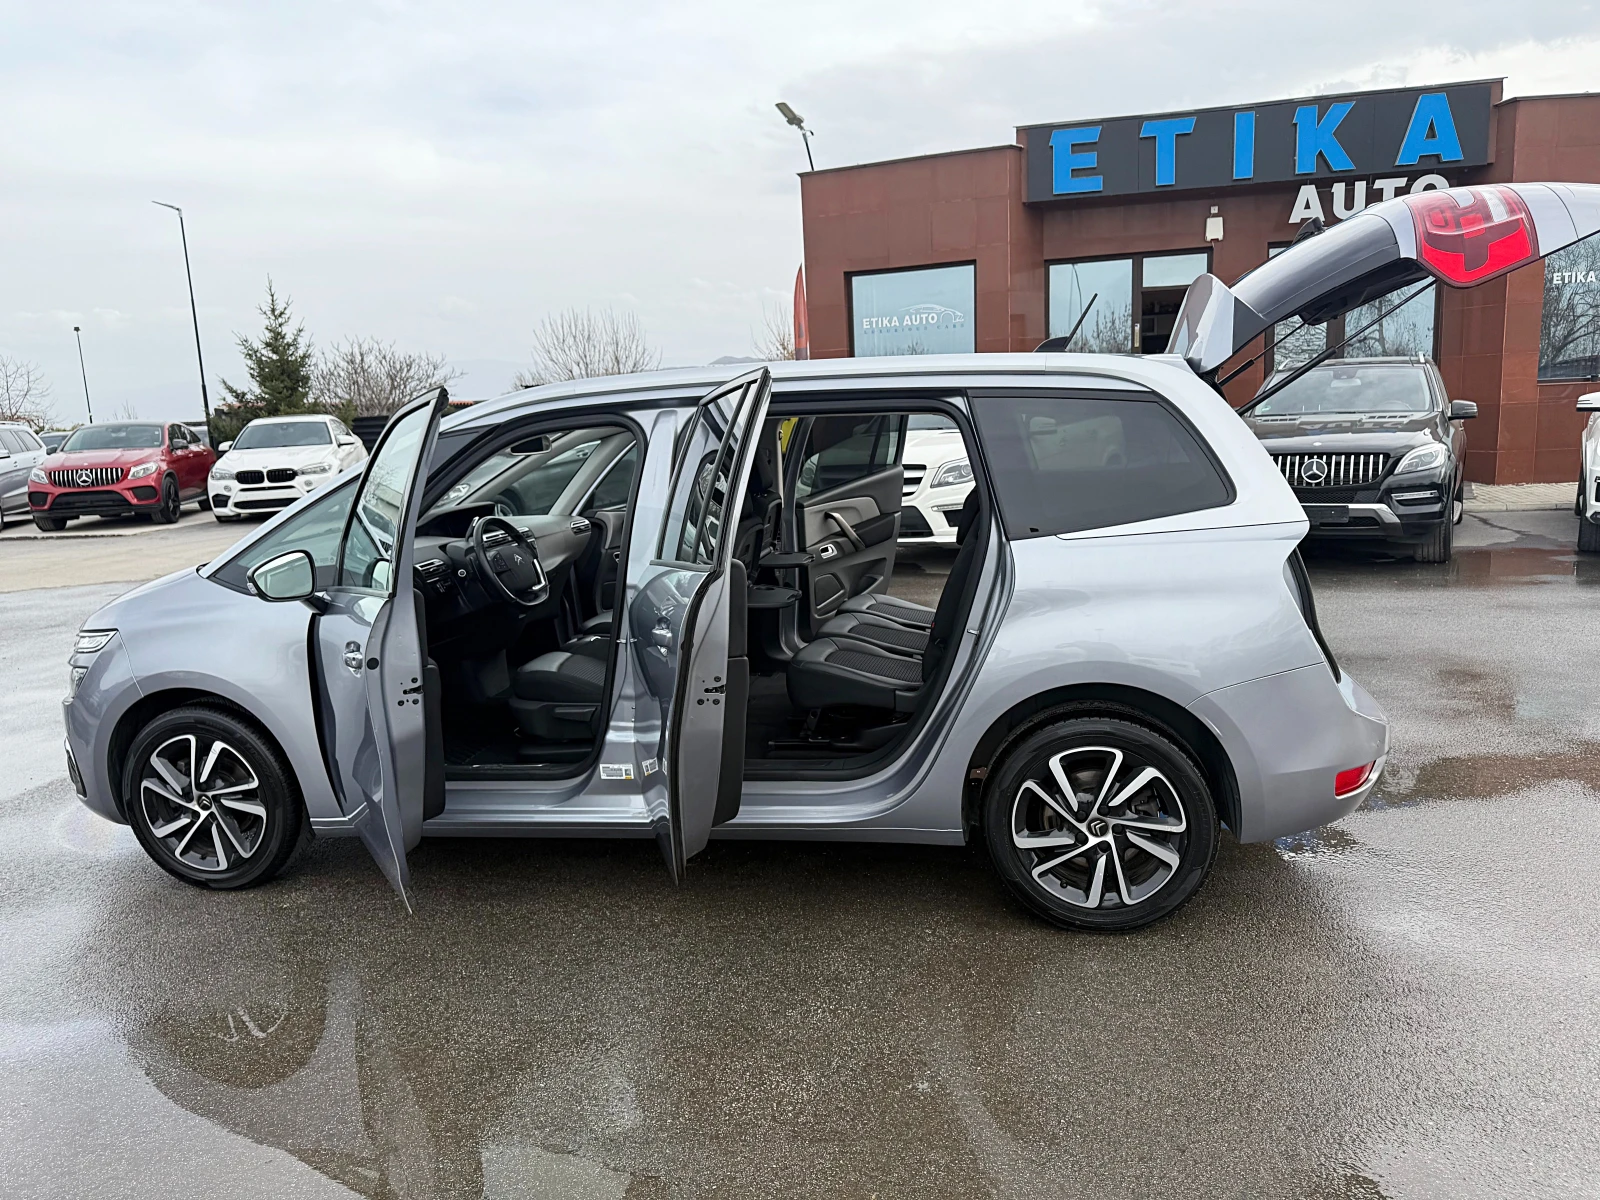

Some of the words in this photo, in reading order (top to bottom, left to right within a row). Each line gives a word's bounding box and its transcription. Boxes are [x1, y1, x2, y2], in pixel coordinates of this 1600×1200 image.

[1049, 93, 1464, 194] ETIKA
[1553, 271, 1596, 284] ETIKA
[862, 316, 900, 329] ETIKA
[903, 313, 938, 326] AUTO
